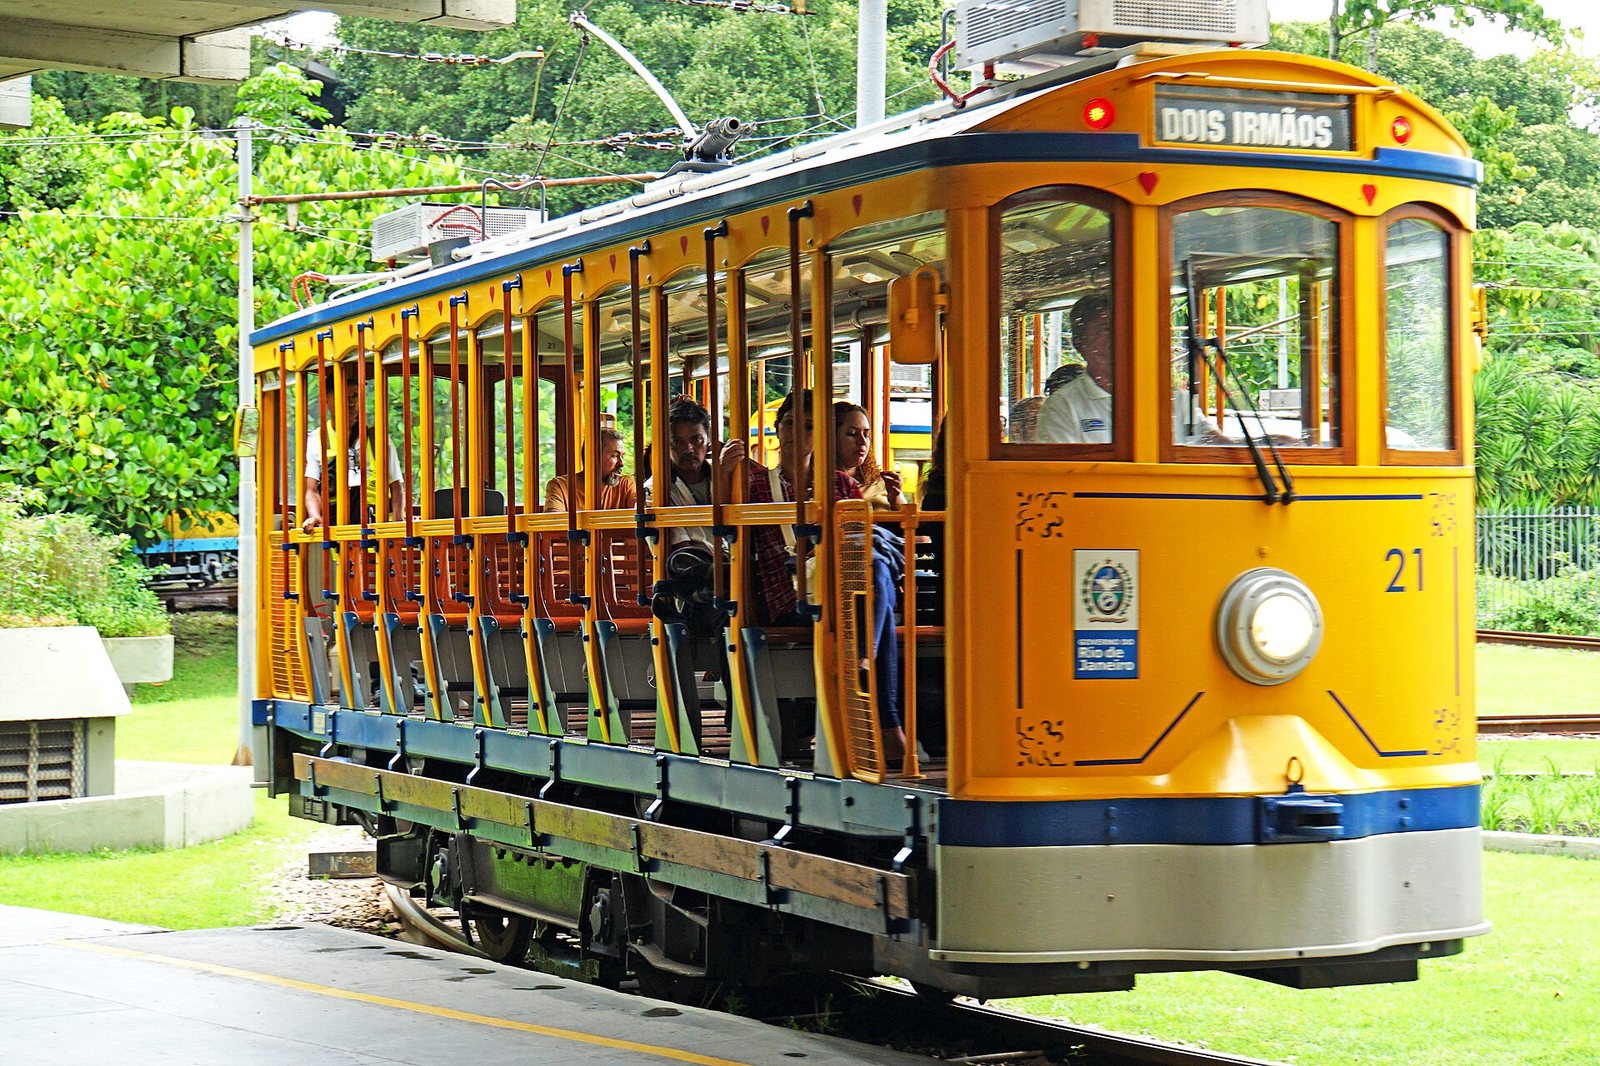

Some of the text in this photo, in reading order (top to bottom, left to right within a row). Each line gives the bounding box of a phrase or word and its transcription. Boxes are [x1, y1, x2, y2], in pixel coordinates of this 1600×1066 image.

[1161, 106, 1333, 148] DOIS IRMÃOS
[547, 342, 556, 350] 21
[1384, 548, 1423, 593] 21
[1077, 646, 1125, 659] Rio de
[1077, 659, 1136, 671] Janeiro
